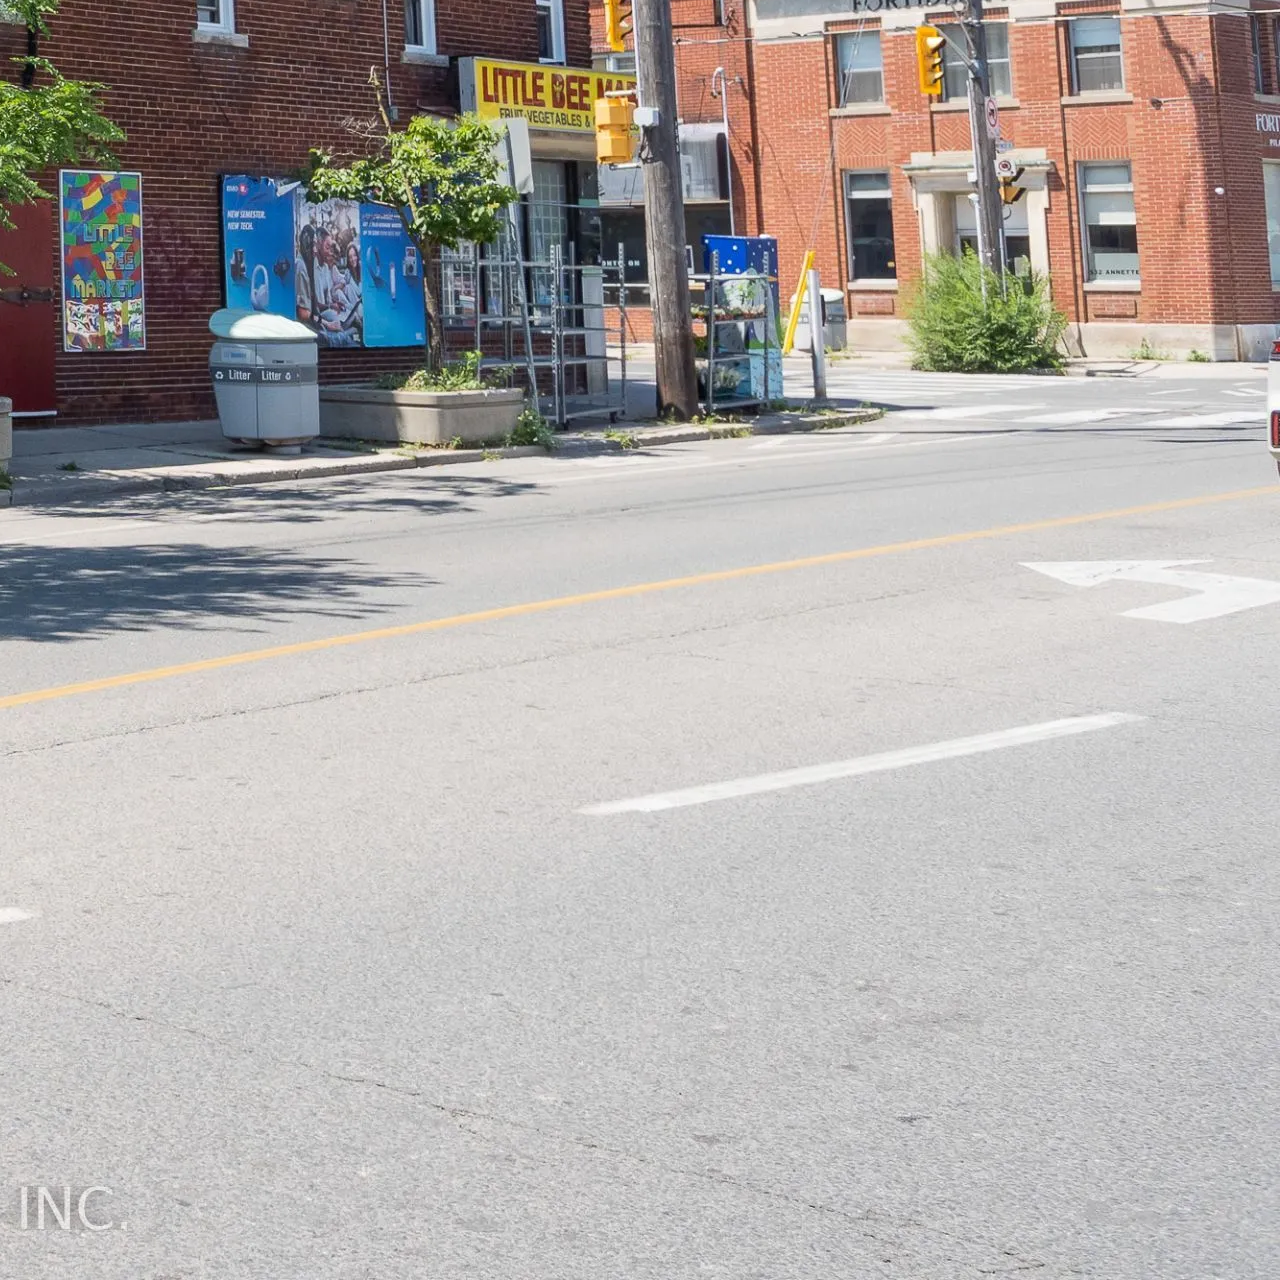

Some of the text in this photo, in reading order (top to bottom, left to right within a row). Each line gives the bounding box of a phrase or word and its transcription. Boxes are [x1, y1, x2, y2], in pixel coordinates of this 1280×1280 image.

[482, 66, 546, 107] LITTLE
[551, 73, 591, 111] BEE
[83, 222, 134, 243] LITTLE
[105, 251, 135, 271] BEE
[71, 278, 135, 298] MARKET
[228, 369, 251, 381] Litter
[261, 370, 281, 381] Litter
